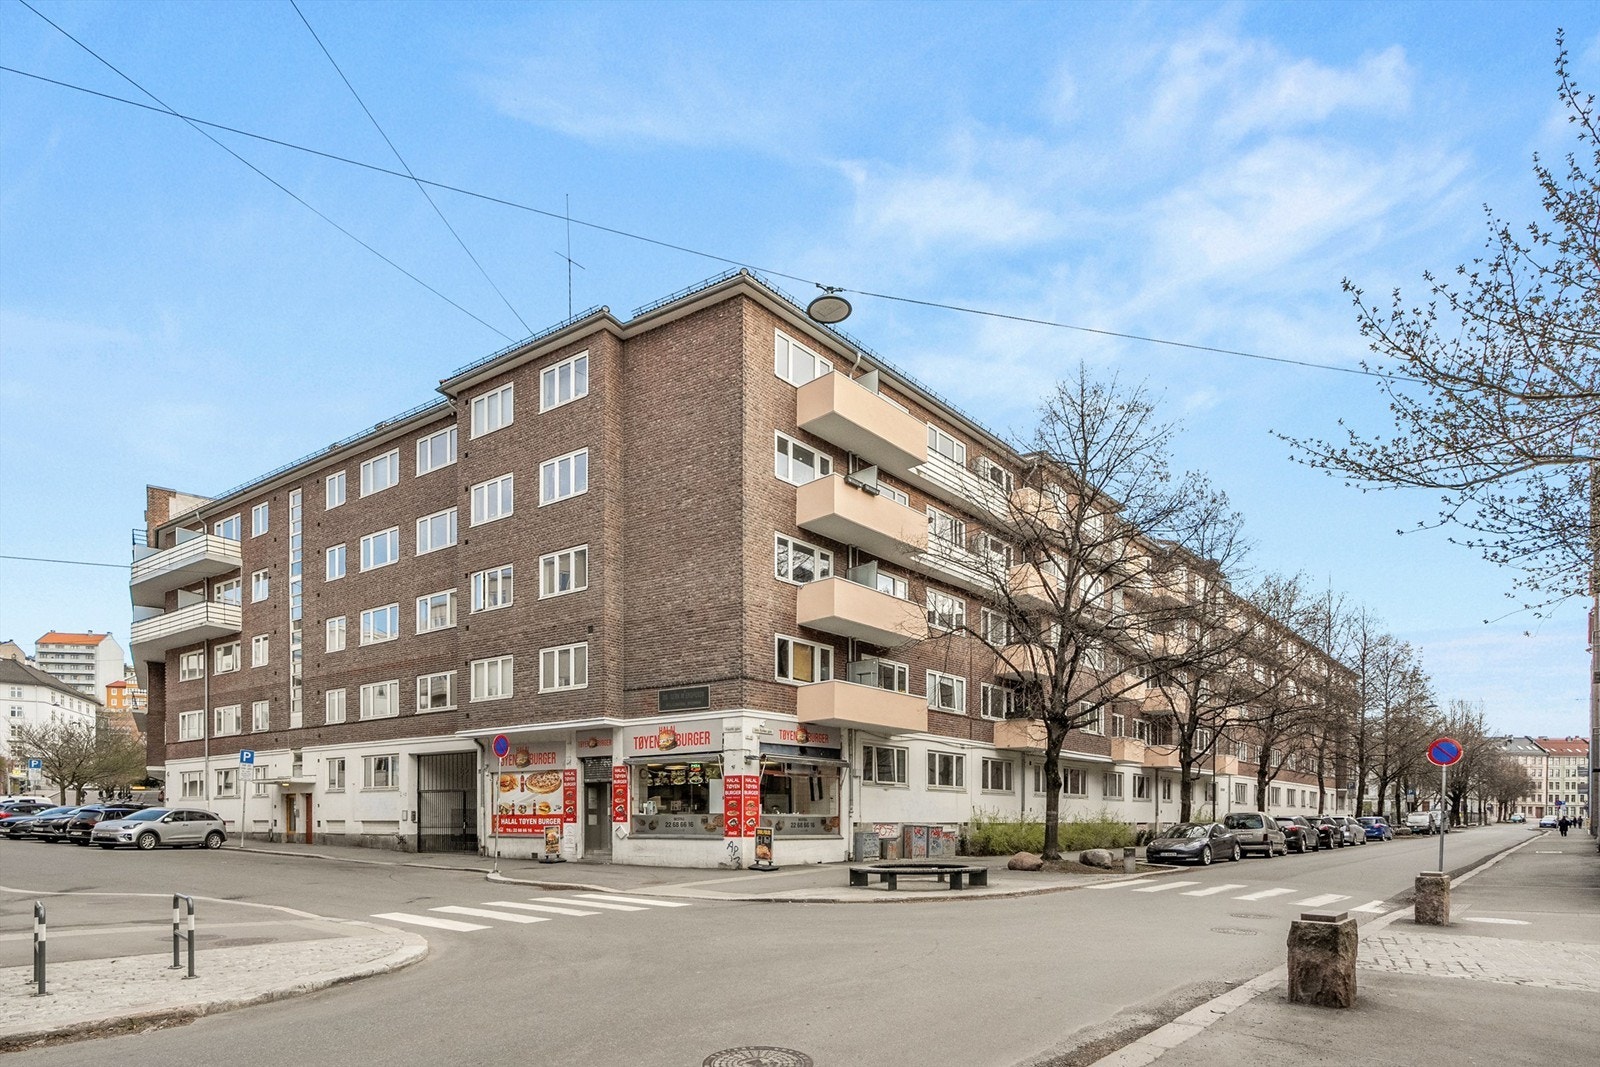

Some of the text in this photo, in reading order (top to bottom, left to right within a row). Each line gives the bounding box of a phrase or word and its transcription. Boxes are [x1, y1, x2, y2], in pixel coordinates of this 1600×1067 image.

[634, 731, 711, 750] TØYEN BURGER
[243, 751, 252, 762] P
[530, 752, 556, 765] BURGER
[31, 760, 39, 768] P
